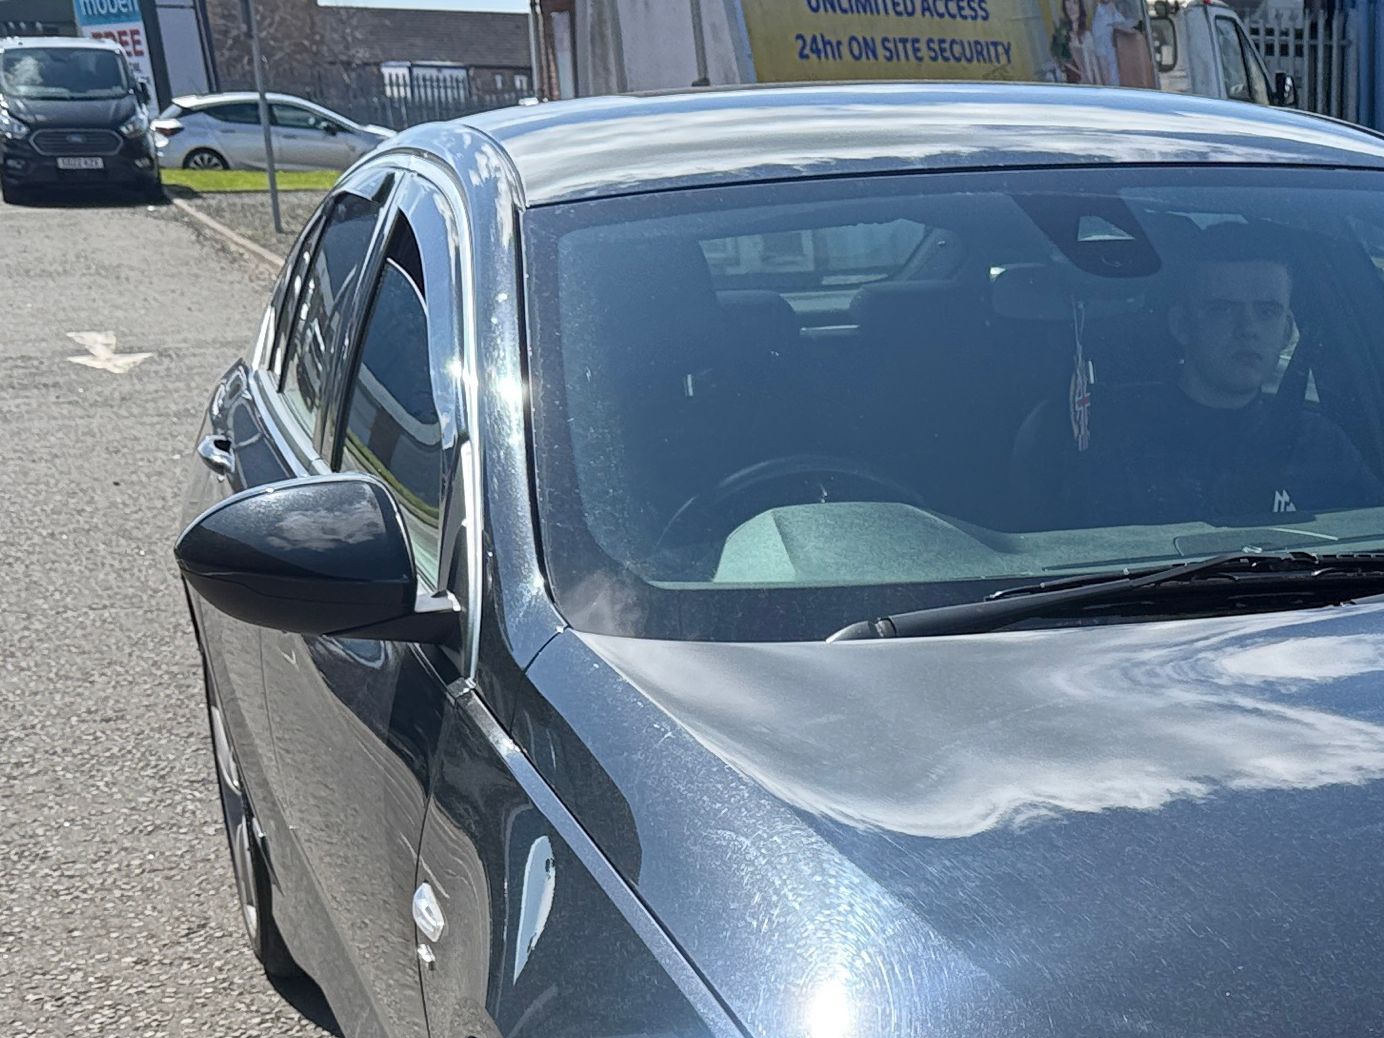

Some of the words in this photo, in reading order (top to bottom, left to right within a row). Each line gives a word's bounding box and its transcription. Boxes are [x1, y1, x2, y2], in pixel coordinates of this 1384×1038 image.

[807, 0, 916, 17] UNLIMITED
[921, 0, 990, 21] ACCESS
[91, 29, 144, 57] EE
[795, 33, 843, 61] 24hr
[848, 35, 878, 61] ON
[881, 36, 924, 62] SITE
[926, 37, 1012, 64] SECURITY
